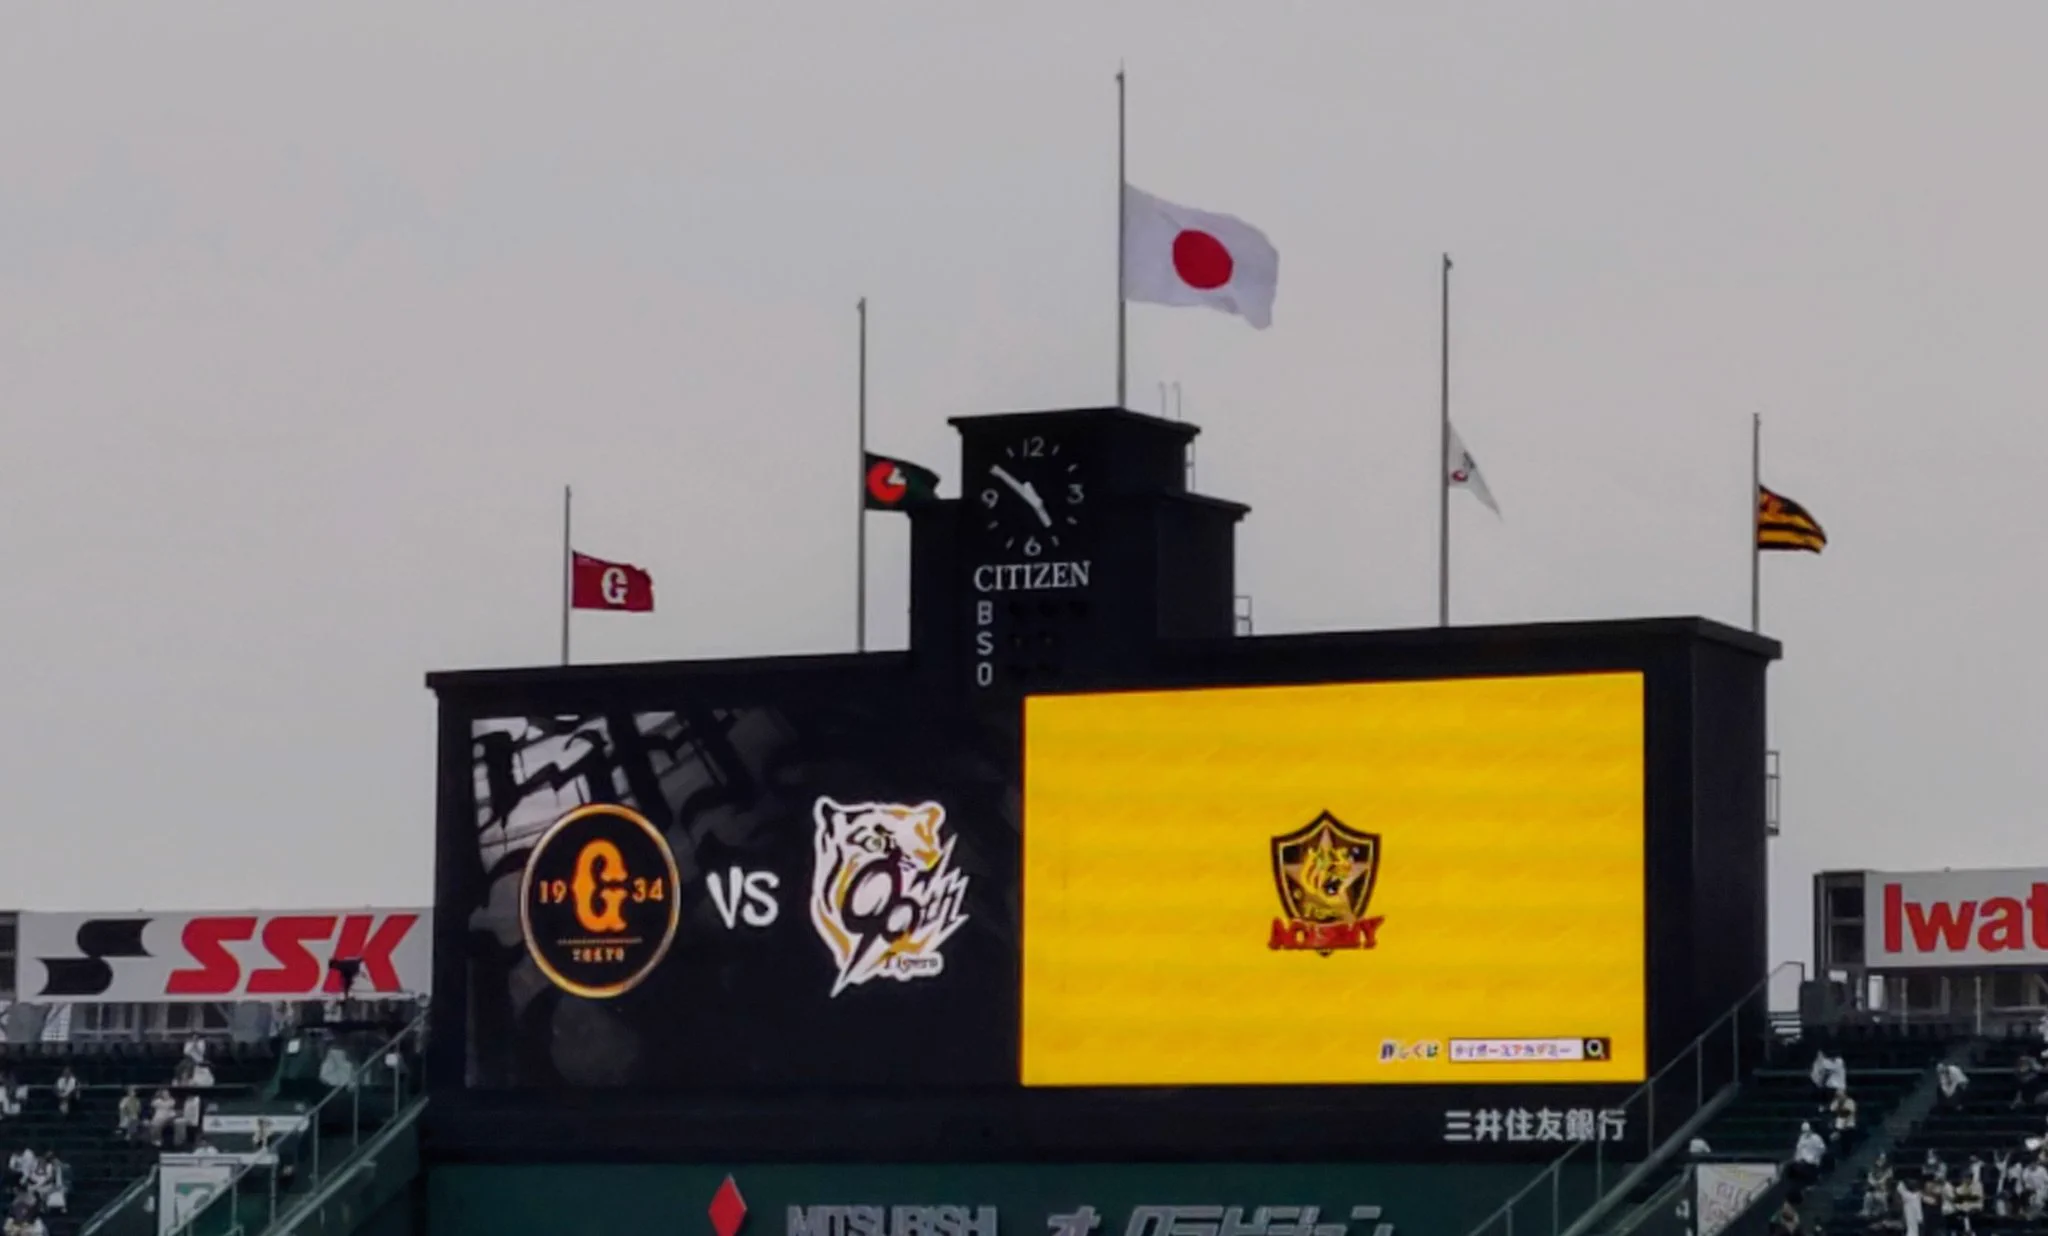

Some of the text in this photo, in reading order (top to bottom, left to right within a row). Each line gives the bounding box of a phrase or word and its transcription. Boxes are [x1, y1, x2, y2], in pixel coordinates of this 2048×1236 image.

[1023, 436, 1045, 458] 12
[981, 488, 999, 509] 9
[1067, 483, 1085, 504] 3
[1023, 536, 1042, 557] 6
[601, 566, 629, 605] G
[973, 560, 1092, 592] CITIZEN
[976, 600, 994, 625] B
[976, 631, 994, 656] S
[539, 838, 664, 933] 19 G 34
[706, 865, 780, 930] VS
[1883, 881, 2048, 954] Iwat
[164, 913, 421, 995] SSK
[1444, 1108, 1627, 1142] 三井住友銀行
